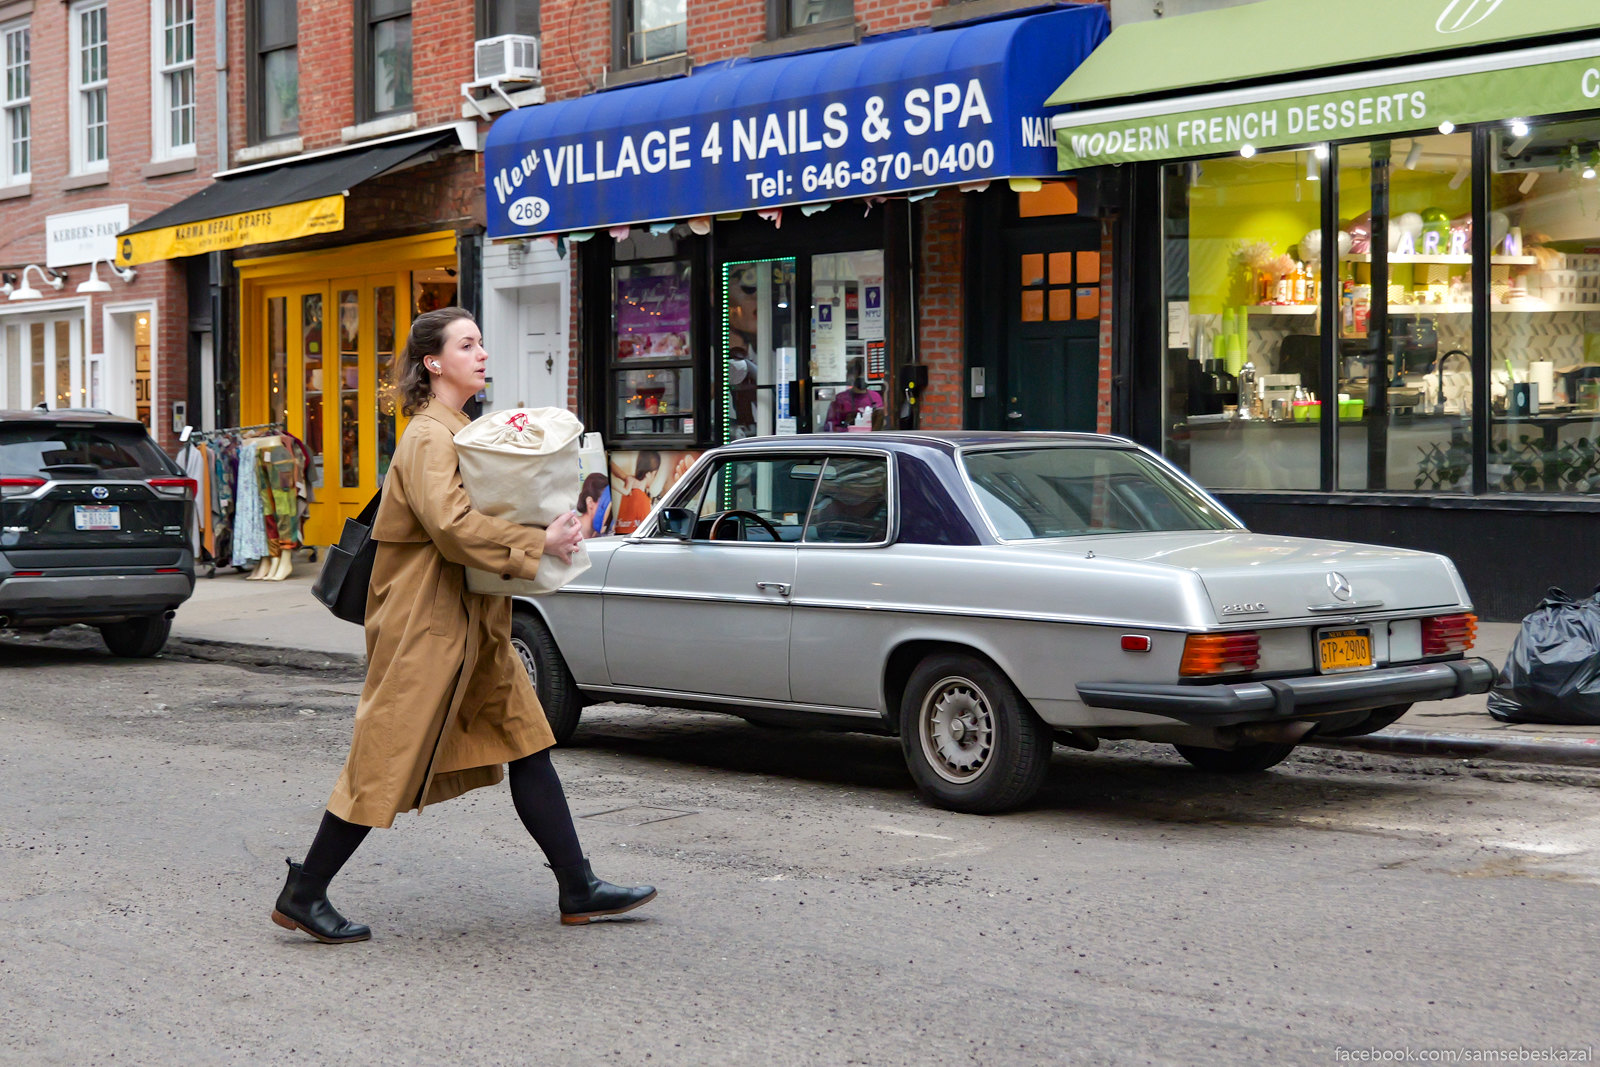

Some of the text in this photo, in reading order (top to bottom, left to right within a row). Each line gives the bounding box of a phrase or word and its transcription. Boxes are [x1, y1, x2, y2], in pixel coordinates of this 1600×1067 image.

[543, 78, 993, 187] VILLAGE 4 NAILS & SPA
[1021, 116, 1057, 148] NAIL
[1071, 90, 1426, 158] MODERN FRENCH DESSERTS
[493, 149, 541, 204] New
[746, 139, 994, 200] Tel: 646-870-0400
[207, 218, 234, 235] NEPAL
[238, 211, 272, 230] CRAFTS
[515, 202, 542, 220] 268
[97, 221, 121, 237] FARM
[865, 309, 882, 318] NYU
